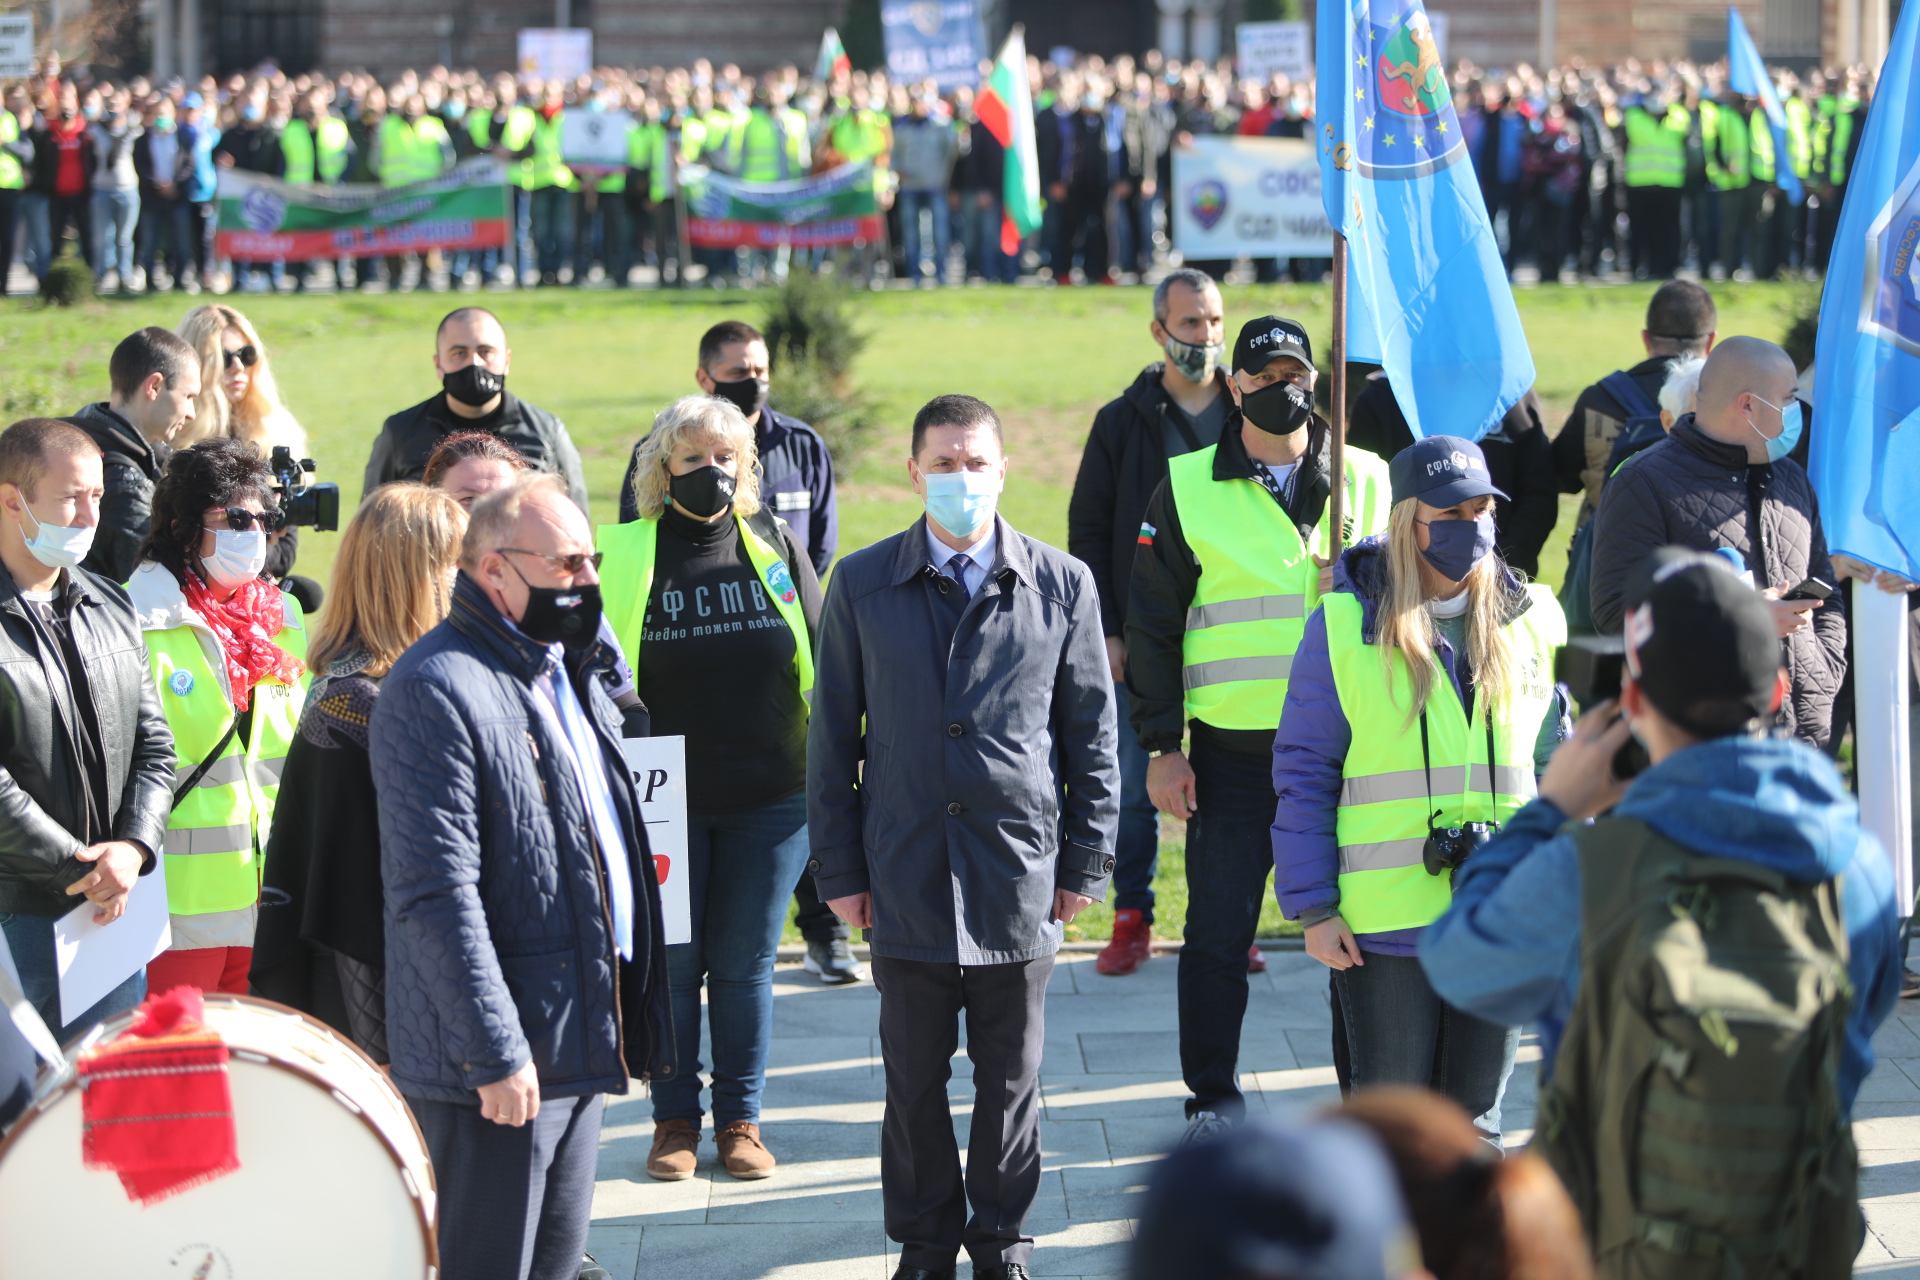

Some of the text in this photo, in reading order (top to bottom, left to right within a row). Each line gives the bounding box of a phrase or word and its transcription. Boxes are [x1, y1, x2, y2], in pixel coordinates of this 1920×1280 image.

[1250, 334, 1269, 349] СФС
[1426, 459, 1451, 476] СФС
[641, 626, 687, 641] Заедно
